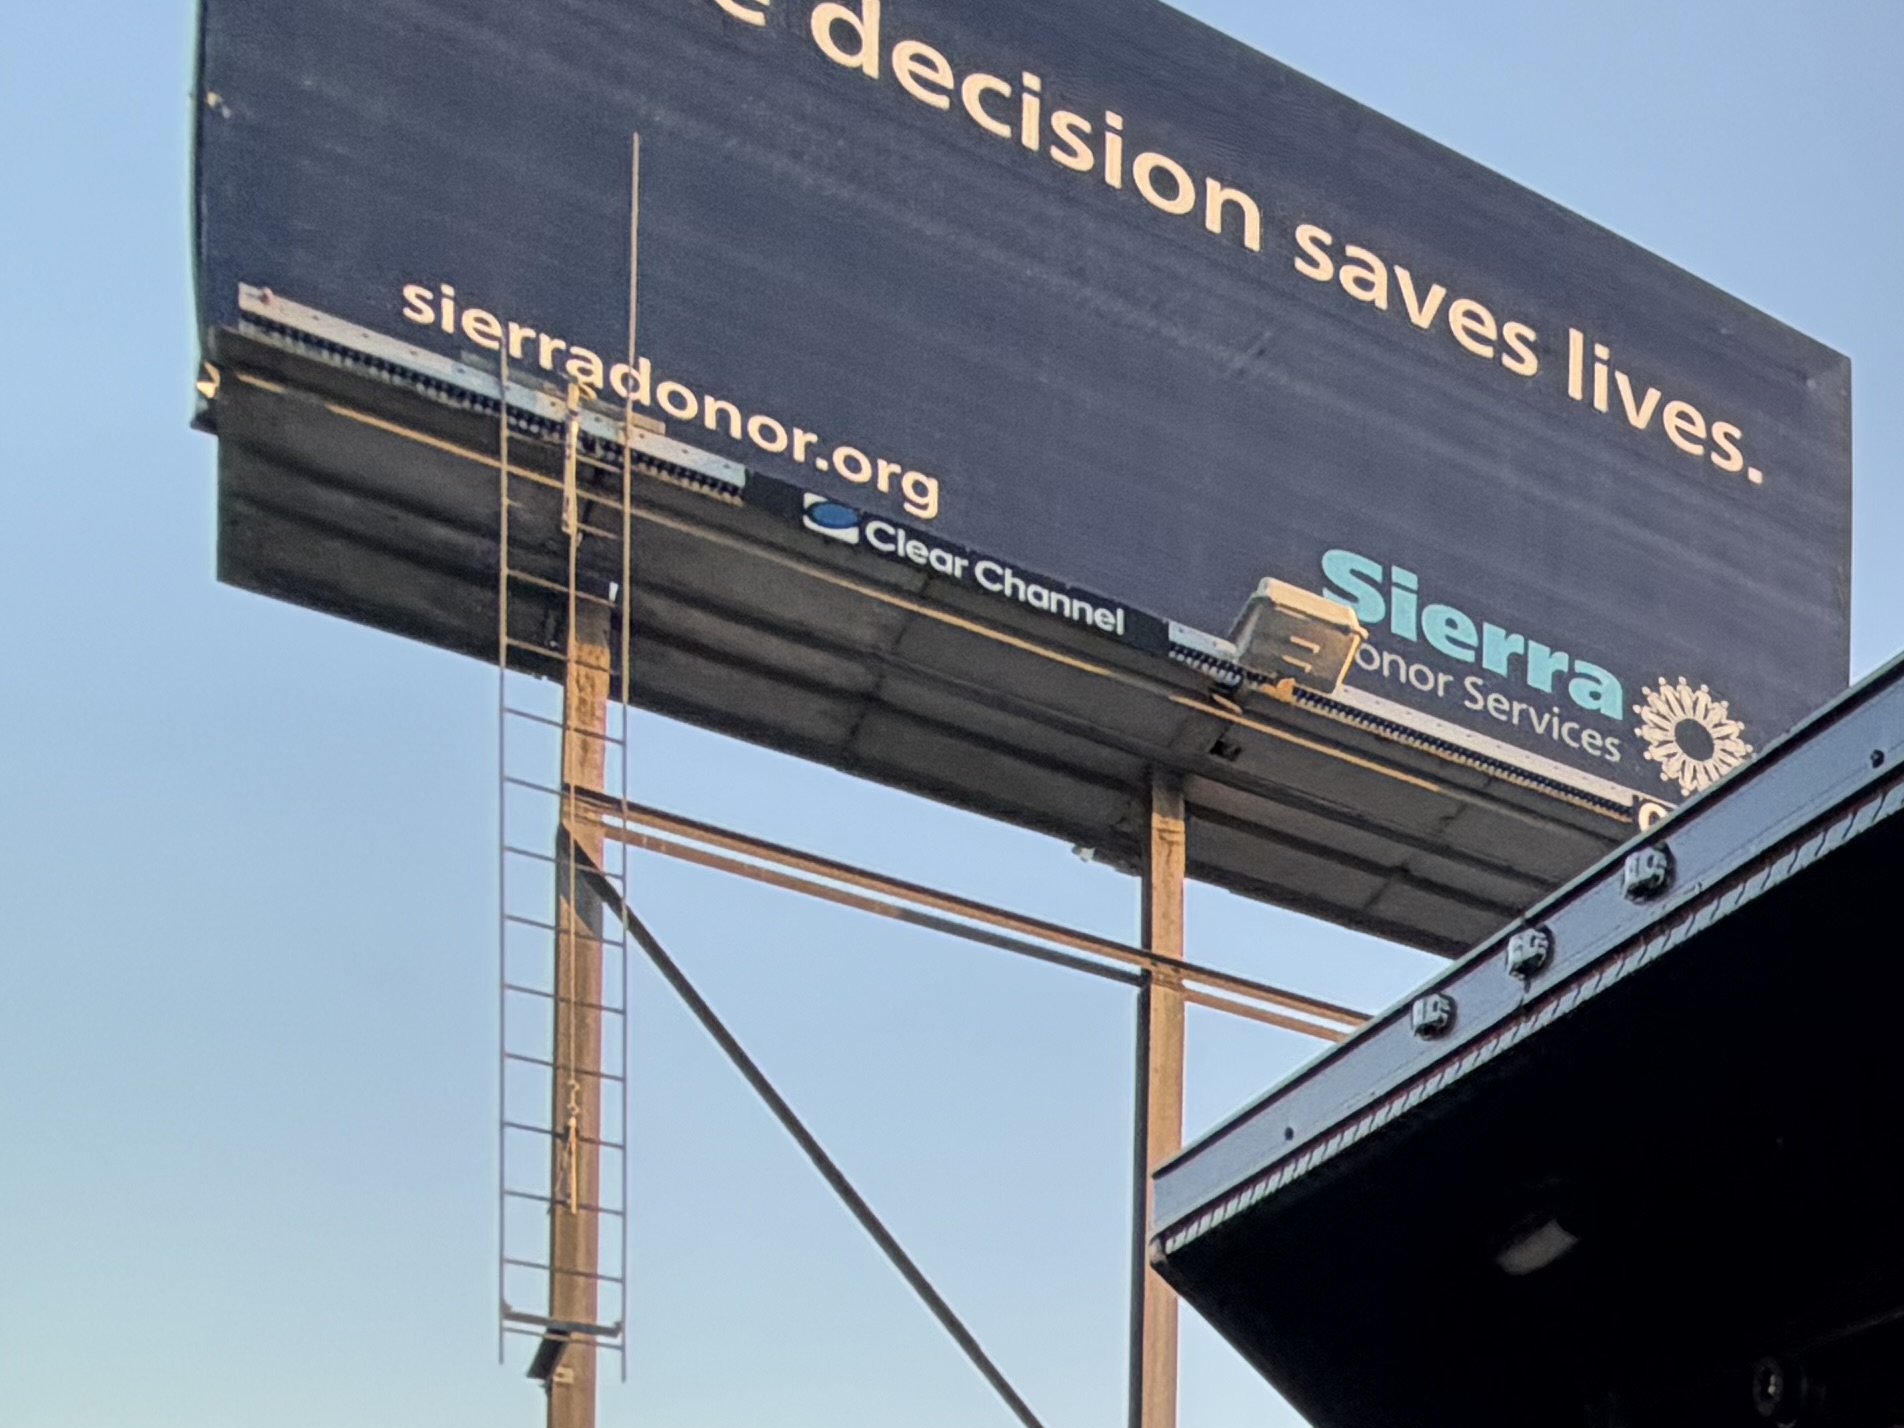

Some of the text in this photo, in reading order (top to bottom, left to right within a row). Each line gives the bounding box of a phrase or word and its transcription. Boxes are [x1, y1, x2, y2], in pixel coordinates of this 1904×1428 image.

[811, 0, 1764, 485] decision saves lives.
[402, 282, 941, 520] sierradonor.org
[864, 519, 1125, 636] Clear Channel
[1321, 548, 1623, 720] Sierra
[1354, 643, 1622, 762] onor Services
